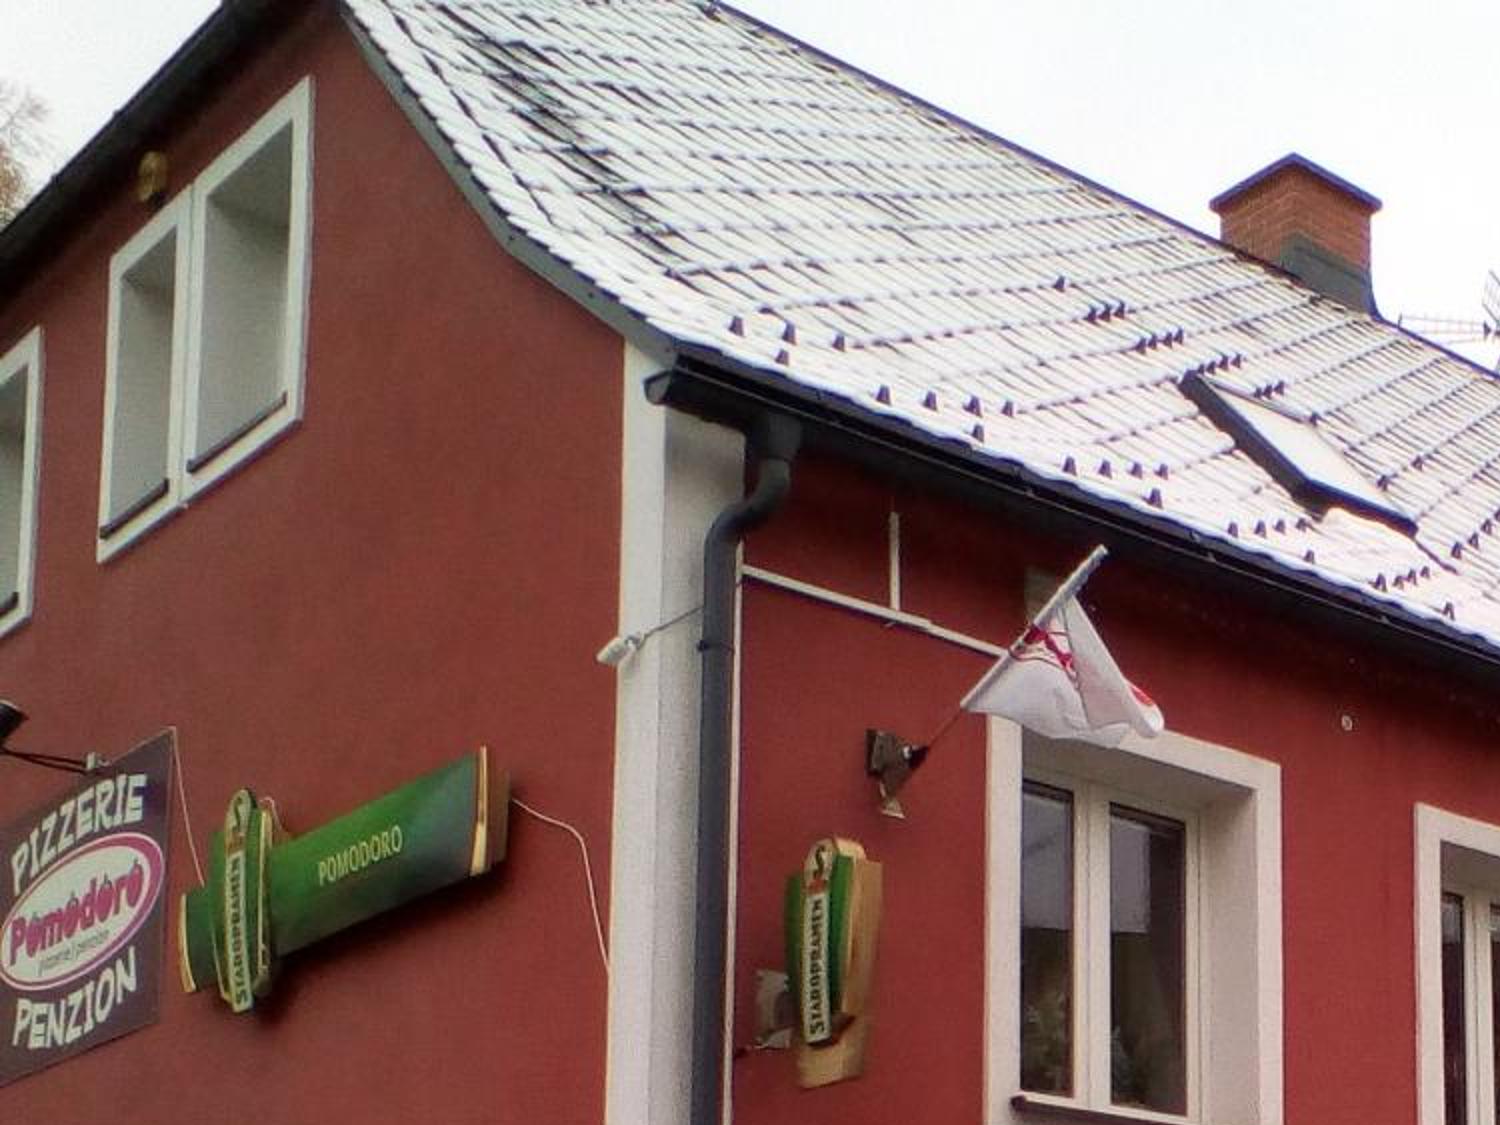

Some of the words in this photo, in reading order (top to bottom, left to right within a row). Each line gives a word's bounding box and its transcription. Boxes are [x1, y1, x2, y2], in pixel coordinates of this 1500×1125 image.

[11, 773, 147, 896] PIZZERIE
[318, 824, 403, 886] POMODORO
[10, 859, 145, 966] Pomodoro
[230, 856, 248, 1005] STAROPRAMEN
[809, 898, 825, 1036] STAROPRAMEN
[12, 945, 138, 1050] PENZION
